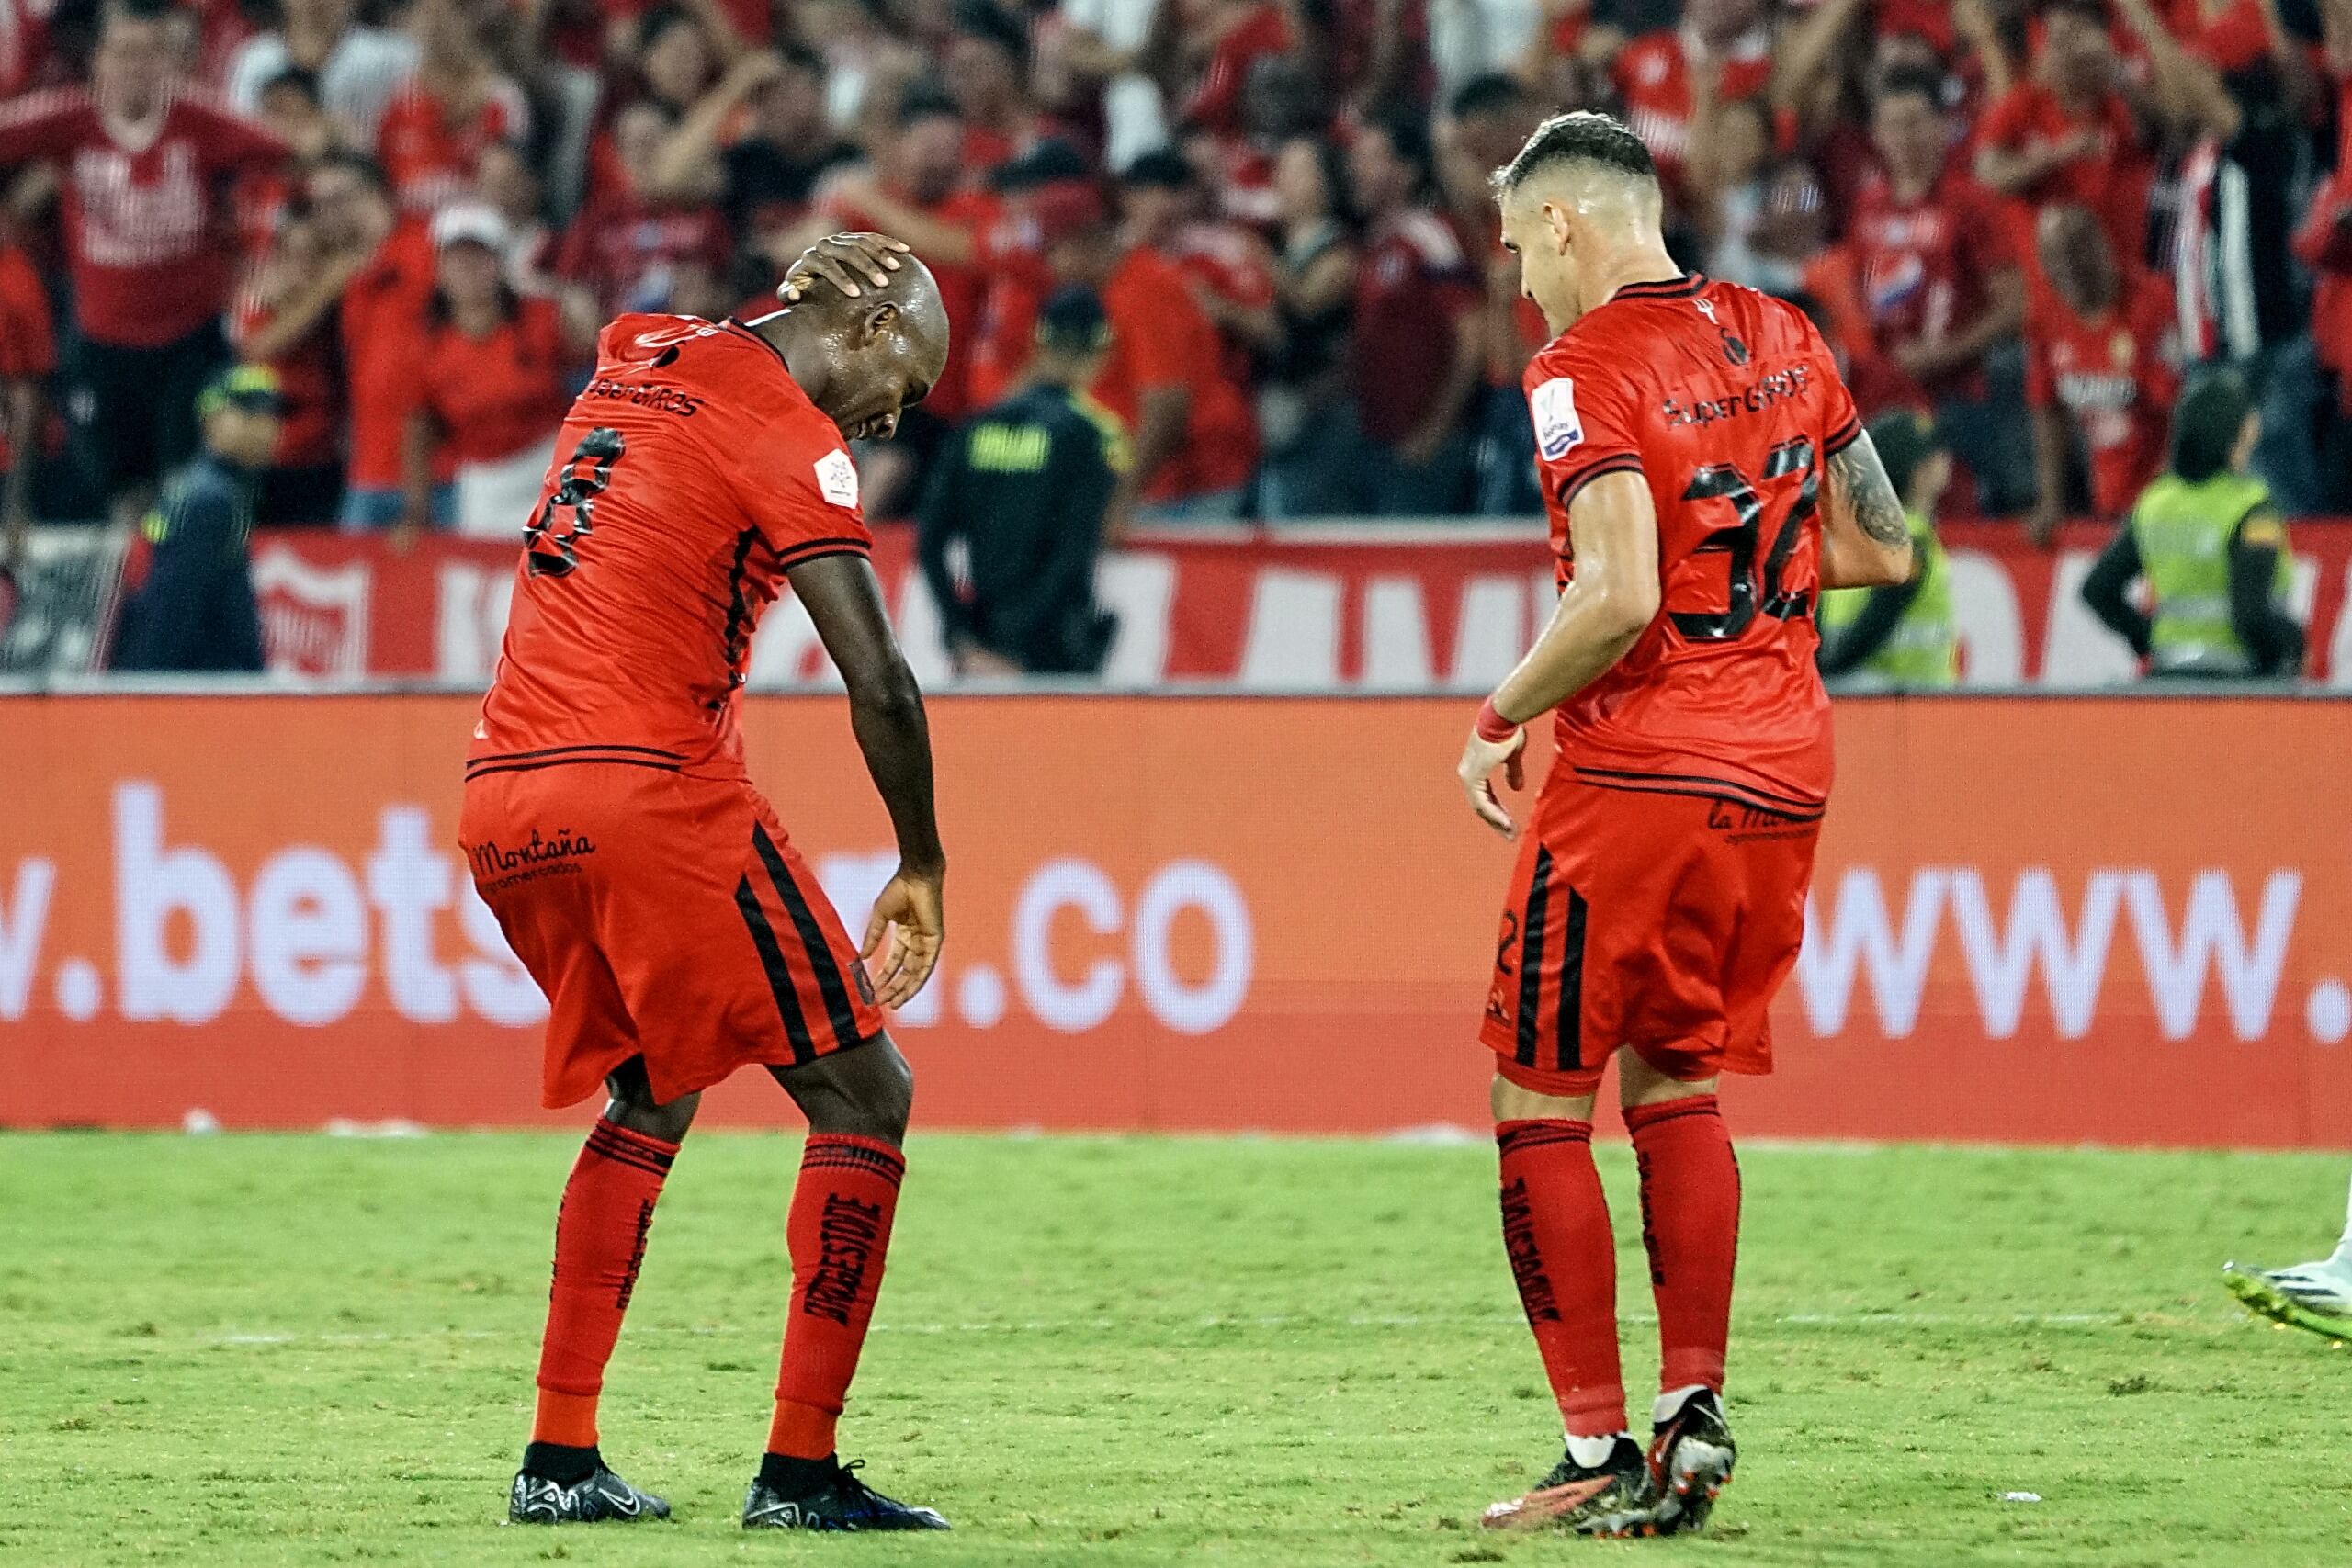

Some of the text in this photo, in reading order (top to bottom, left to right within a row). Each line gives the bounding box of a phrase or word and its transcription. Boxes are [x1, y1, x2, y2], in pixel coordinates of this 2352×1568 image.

[521, 426, 626, 578] 8
[1666, 434, 1817, 641] 32
[471, 828, 597, 875] Montaña
